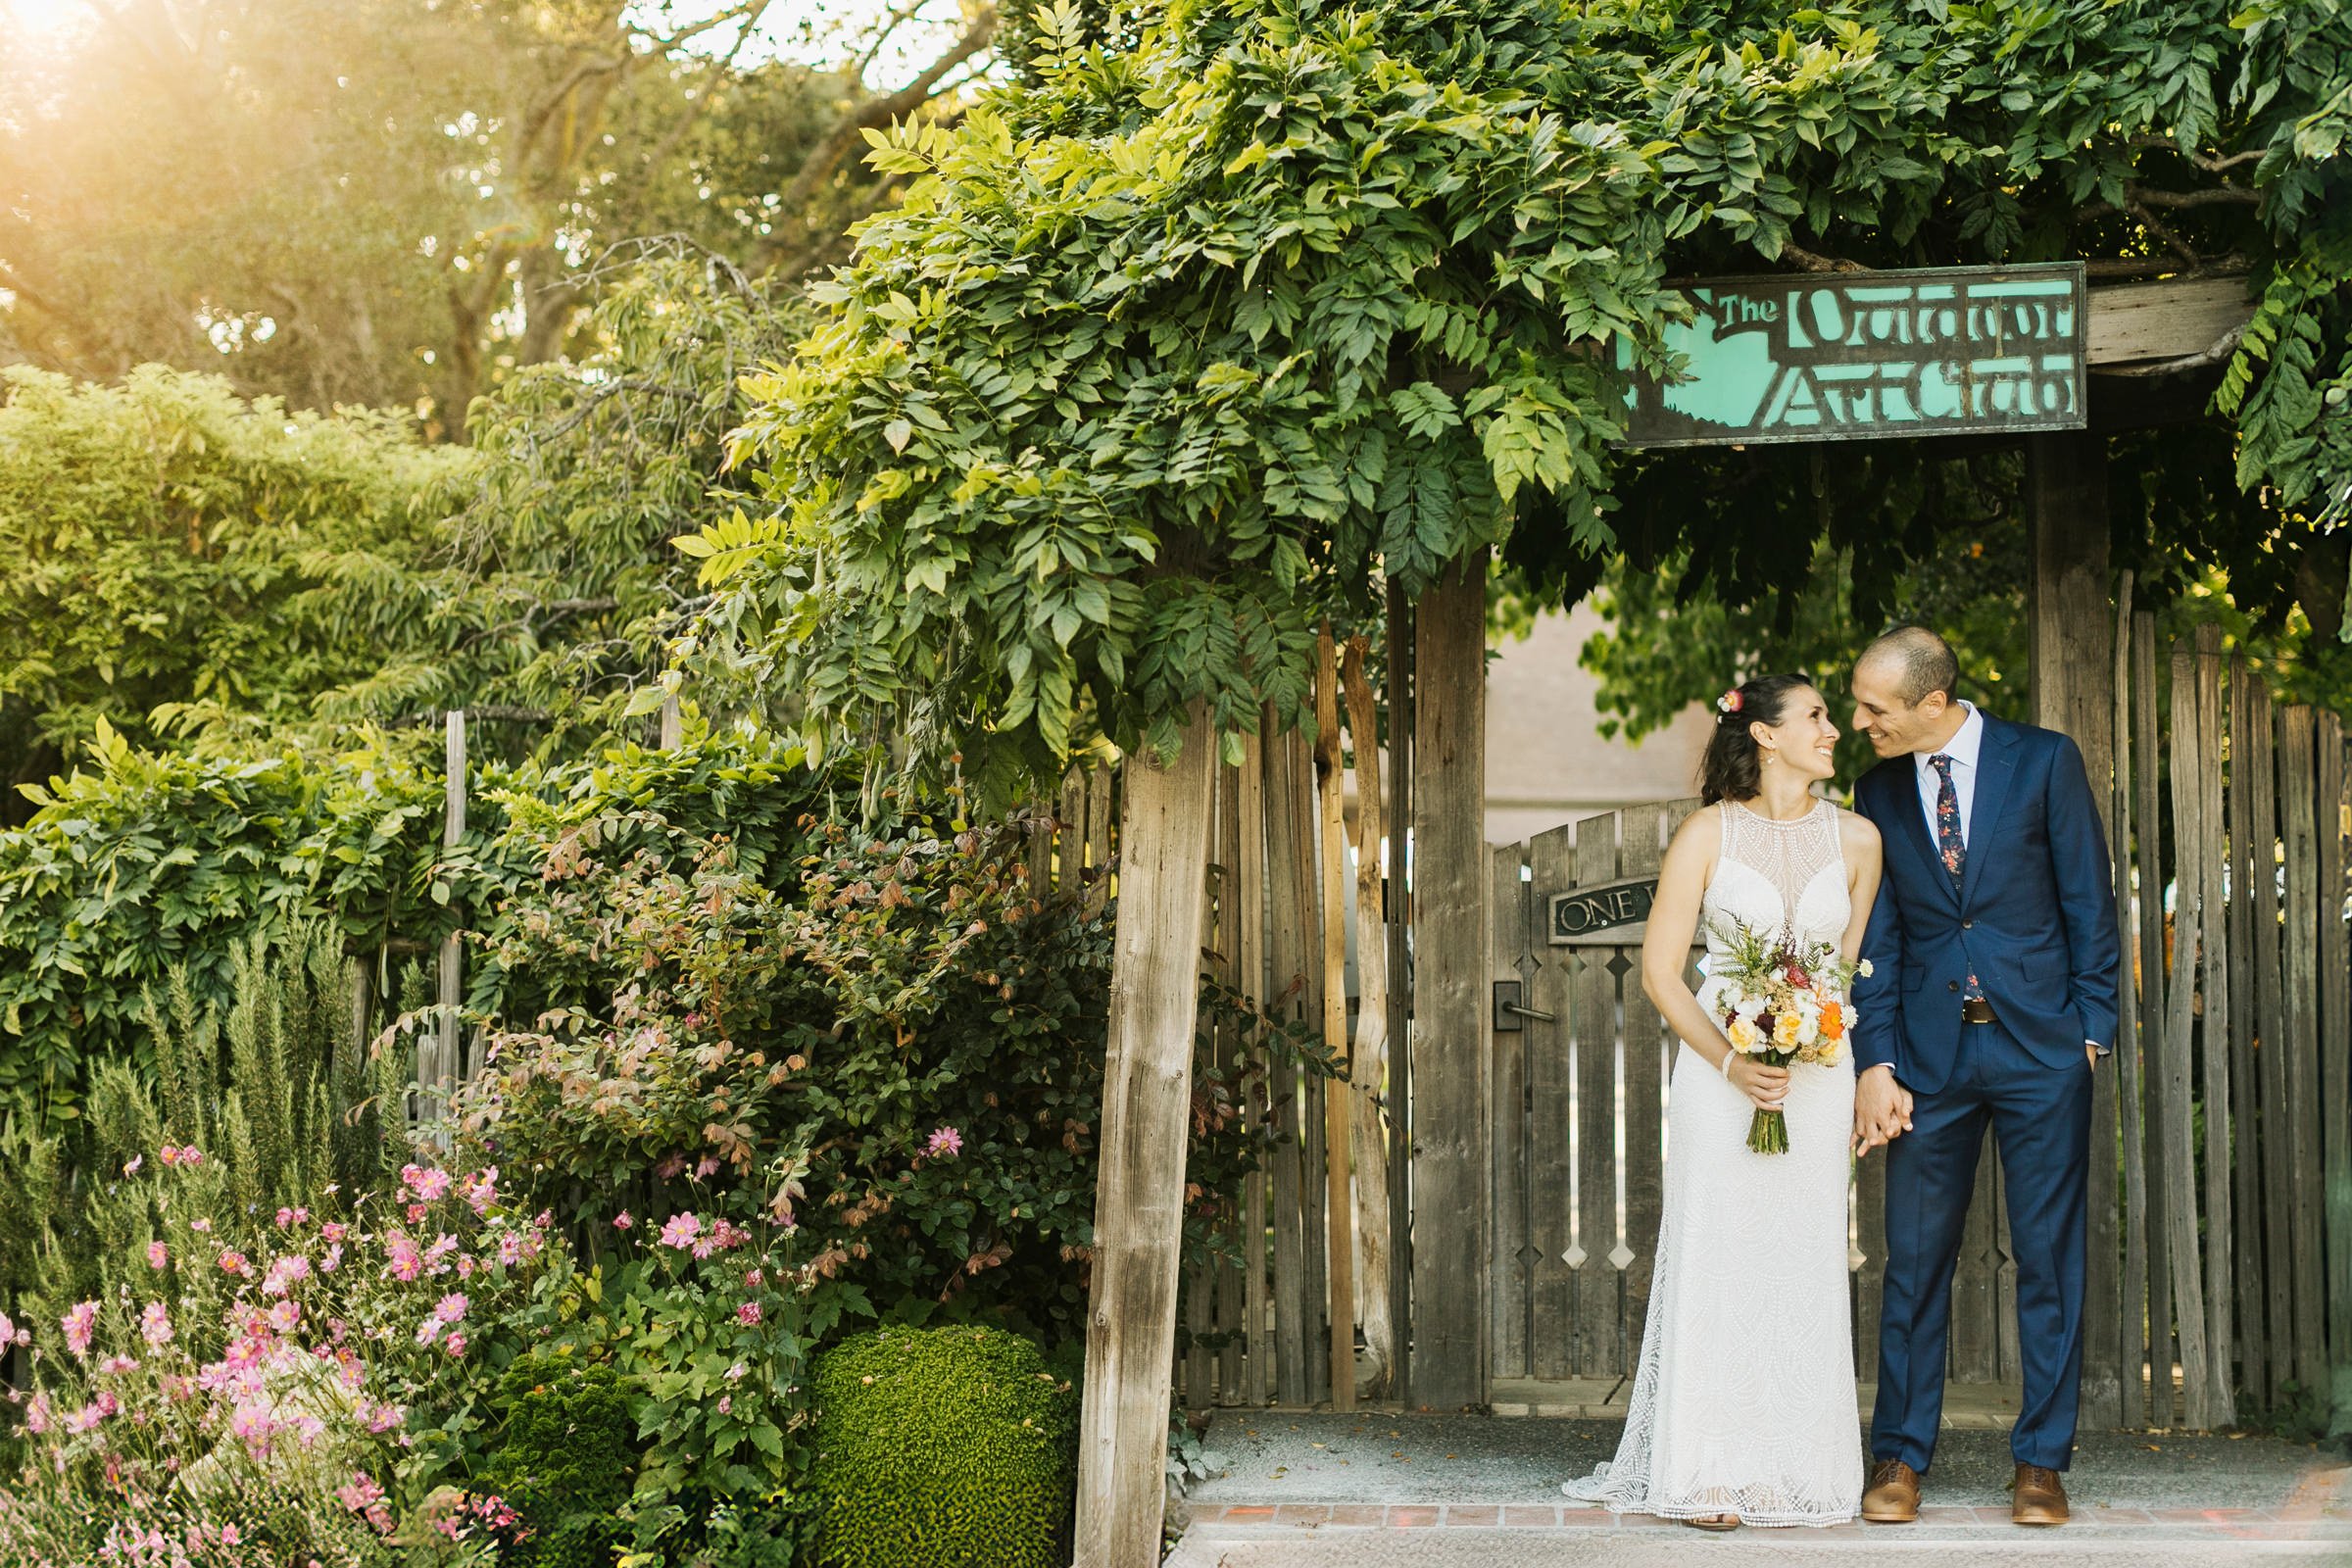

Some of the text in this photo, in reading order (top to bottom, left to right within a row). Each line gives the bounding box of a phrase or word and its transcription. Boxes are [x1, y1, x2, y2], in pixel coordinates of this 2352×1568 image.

[1718, 278, 2072, 346] The Outdoor
[1761, 355, 2072, 428] Art Club
[1560, 889, 1637, 932] ONE
